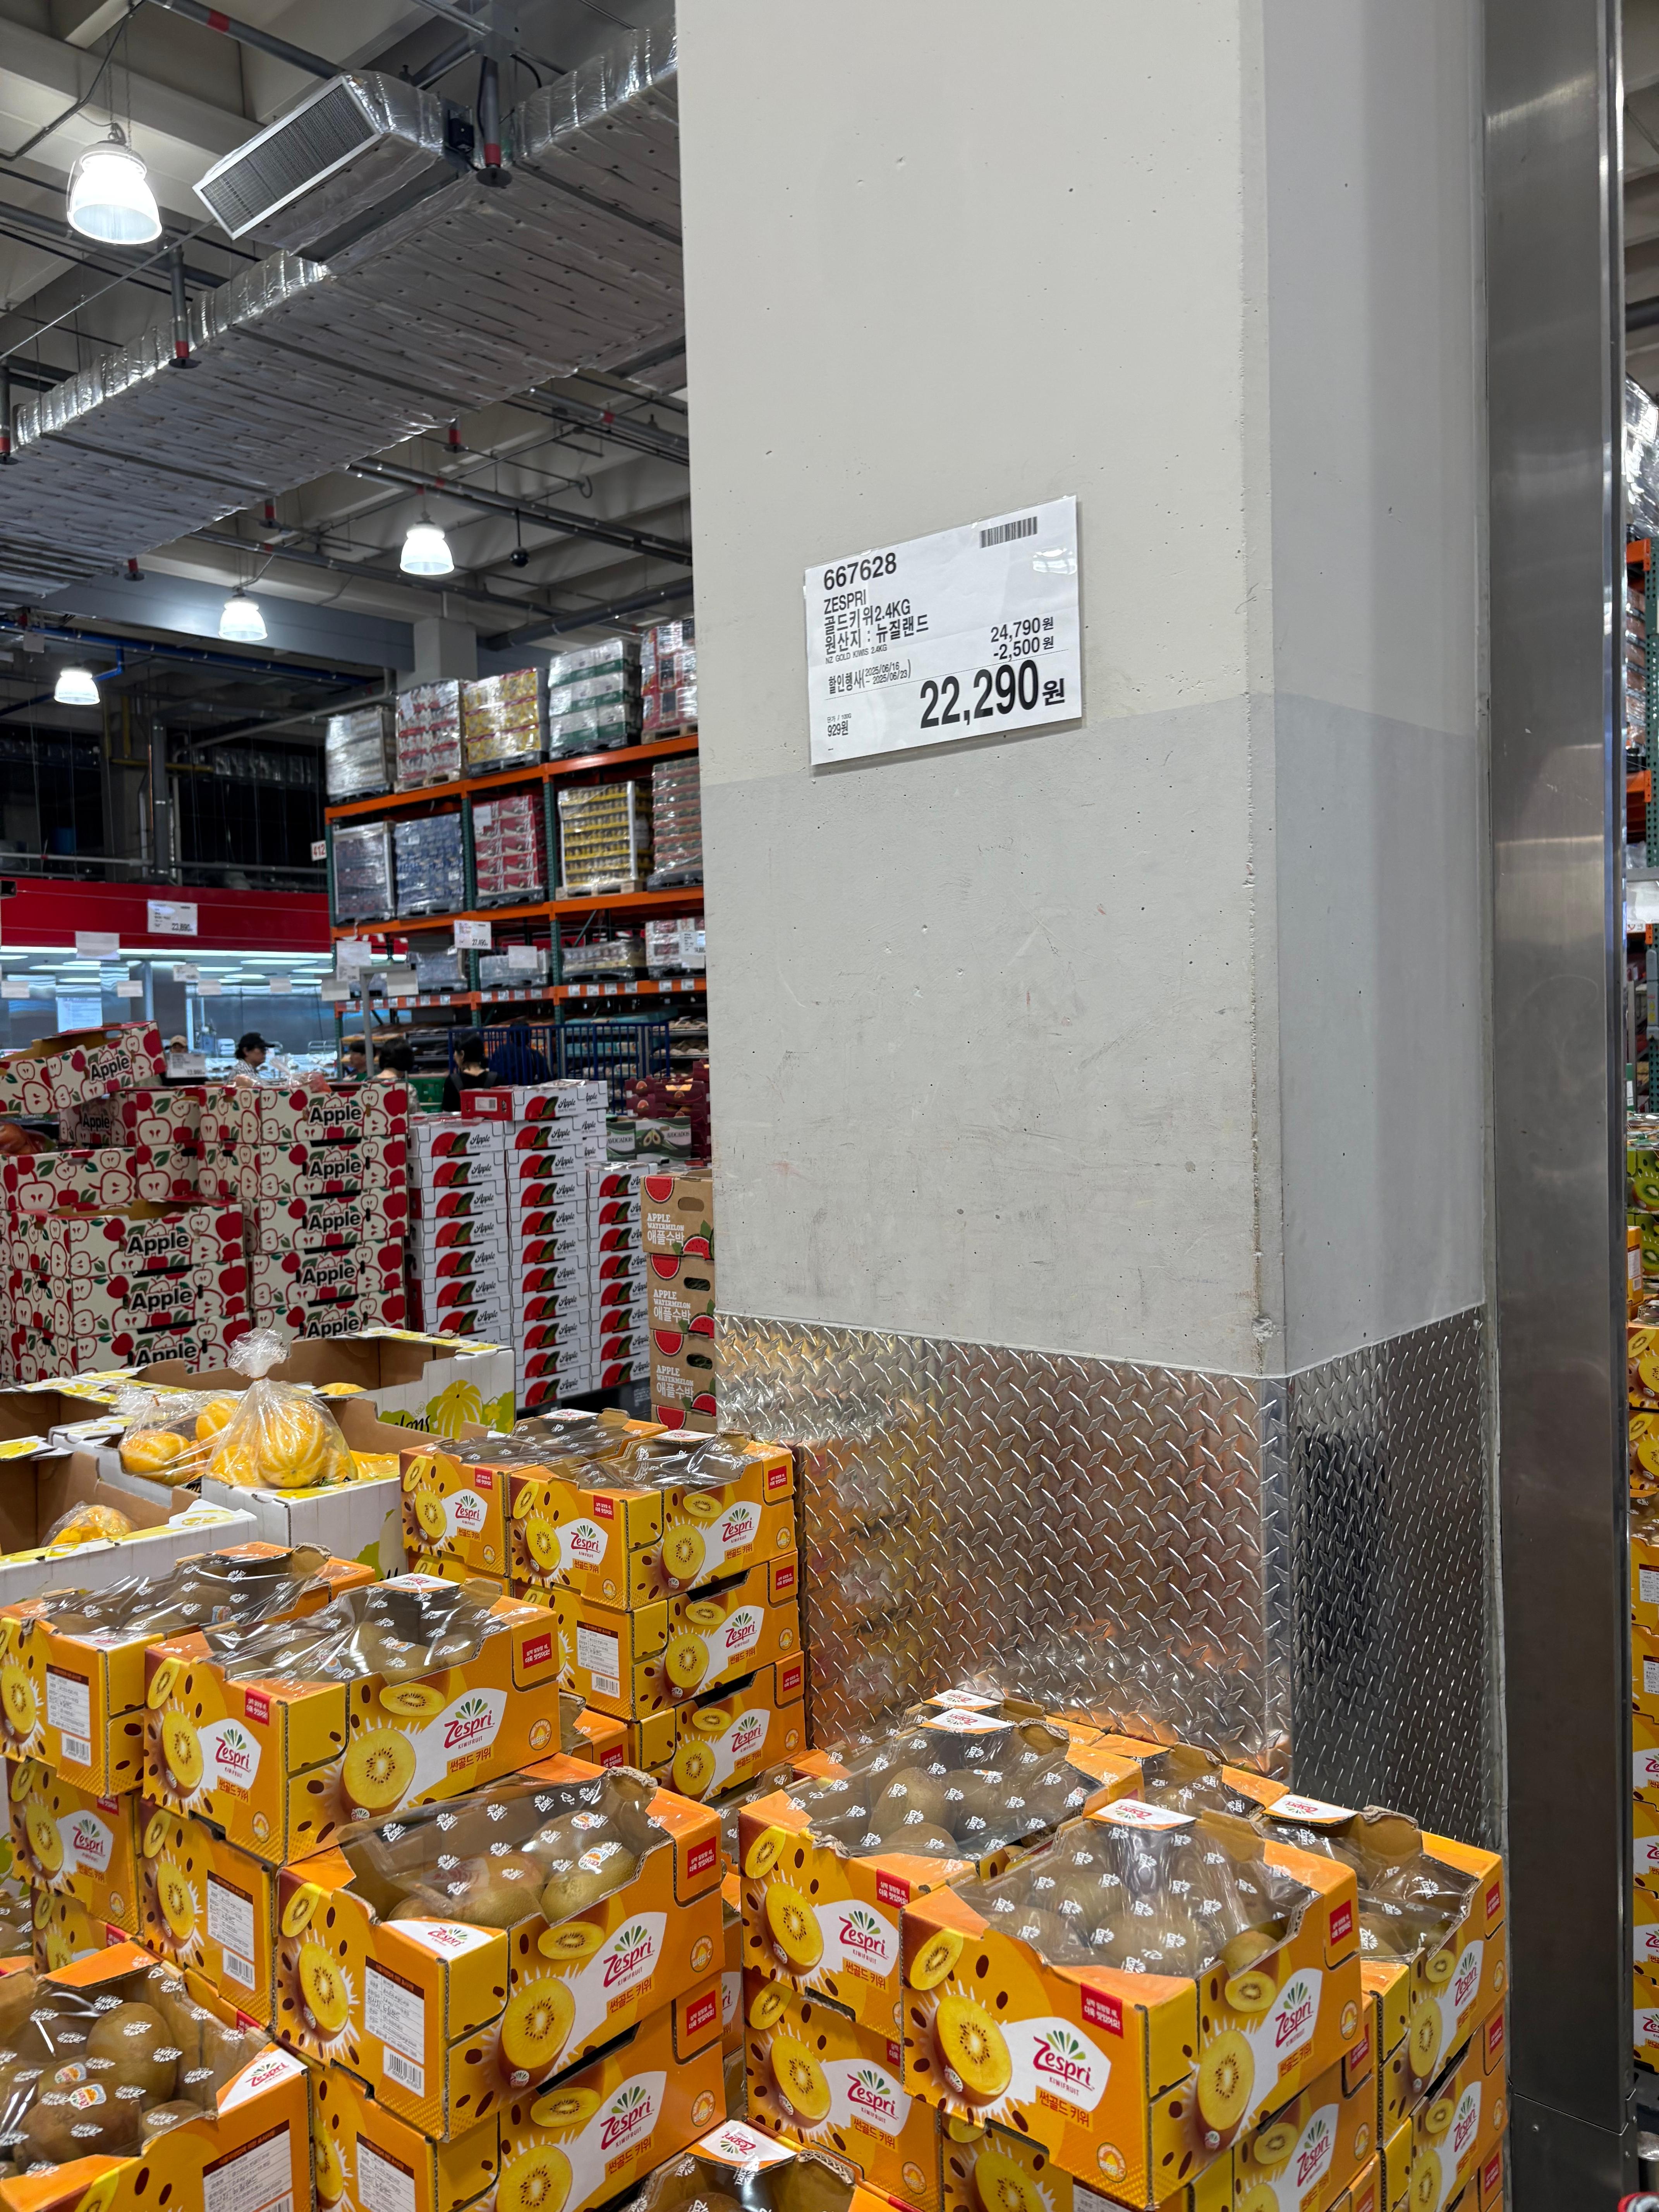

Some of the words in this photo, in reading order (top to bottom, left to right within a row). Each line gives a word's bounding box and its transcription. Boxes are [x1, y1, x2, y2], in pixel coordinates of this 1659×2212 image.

[824, 553, 897, 591] 667628
[824, 589, 867, 615] ZESPRI
[825, 627, 861, 655] 원산지
[876, 614, 928, 643] 뉴질랜드
[835, 653, 850, 662] GOLD
[91, 1055, 129, 1080] Apple
[558, 1099, 576, 1108] Apple
[83, 1113, 110, 1131] Apple
[310, 1105, 362, 1123] Apple
[470, 1134, 490, 1145] Apple
[551, 1128, 570, 1139] Apple
[607, 1136, 634, 1144] AVOCADOS
[309, 1156, 362, 1180] Apple
[471, 1164, 491, 1175] Apple
[555, 1156, 574, 1166] Apple
[557, 1184, 575, 1194] Apple
[474, 1194, 494, 1204] Apple
[309, 1211, 361, 1233] Apple
[556, 1212, 575, 1223] Apple
[647, 1212, 671, 1223] APPLE
[474, 1223, 494, 1233] Apple
[647, 1223, 684, 1231] WATERMELON
[128, 1231, 189, 1255] Apple
[557, 1240, 576, 1250] Apple
[647, 1230, 684, 1247] 애플수박
[475, 1252, 495, 1263] Apple
[631, 1255, 647, 1266] Appl
[302, 1264, 355, 1286] Apple
[558, 1267, 576, 1278] Apple
[476, 1281, 496, 1293] Apple
[632, 1282, 647, 1293] Appl
[653, 1289, 677, 1300] APPLE
[131, 1288, 193, 1310] Apple
[558, 1295, 577, 1307] Apple
[654, 1298, 691, 1309] WATERMELON
[477, 1310, 498, 1322] Apple
[654, 1307, 691, 1324] 애플수박
[307, 1317, 359, 1338] Apple
[558, 1324, 577, 1334] Apple
[560, 1351, 578, 1362] Apple
[656, 1365, 680, 1377] APPLE
[560, 1379, 578, 1390] Apple
[656, 1374, 694, 1386] WATERMELON
[657, 1382, 694, 1402] 애플수박
[455, 1502, 481, 1522] Zespri
[722, 1517, 754, 1542] Zespri
[570, 1532, 600, 1553] Zespri
[726, 1548, 742, 1559] 썬골드
[742, 1543, 753, 1553] 키위
[725, 1621, 756, 1648] Zespri
[730, 1652, 745, 1664] 썬골드
[745, 1647, 756, 1658] 키위
[444, 1710, 494, 1748] Zespri
[458, 1735, 483, 1749] KIWIFRUIT
[732, 1724, 763, 1752] Zespri
[216, 1736, 251, 1772] Zespri
[450, 1754, 474, 1772] 썬골드
[476, 1746, 491, 1762] 키위
[839, 1916, 888, 1960] Zespri
[603, 1936, 654, 1987] Zespri
[853, 1949, 876, 1964] KIWIFRUIT
[618, 1966, 642, 1986] KIWIFRUIT
[846, 1961, 870, 1982] 썬골드
[871, 1973, 886, 1990] 키위
[610, 1993, 634, 2013] 썬골드
[636, 1980, 651, 1998] 키위
[1275, 1996, 1314, 2048] Zespri
[1033, 2036, 1094, 2091] Zespri
[1049, 2076, 1079, 2096] KIWIFRUIT
[847, 2073, 898, 2120] Zespri
[861, 2107, 886, 2123] KIWIFRUIT
[1039, 2090, 1068, 2116] 썬골드
[1070, 2106, 1089, 2127] 키위
[600, 2095, 653, 2150] Zespri
[616, 2128, 641, 2148] KIWIFRUIT
[854, 2118, 878, 2139] 썬골드
[879, 2133, 895, 2149] 키위
[608, 2151, 634, 2173] 썬골드
[635, 2136, 651, 2154] 키위
